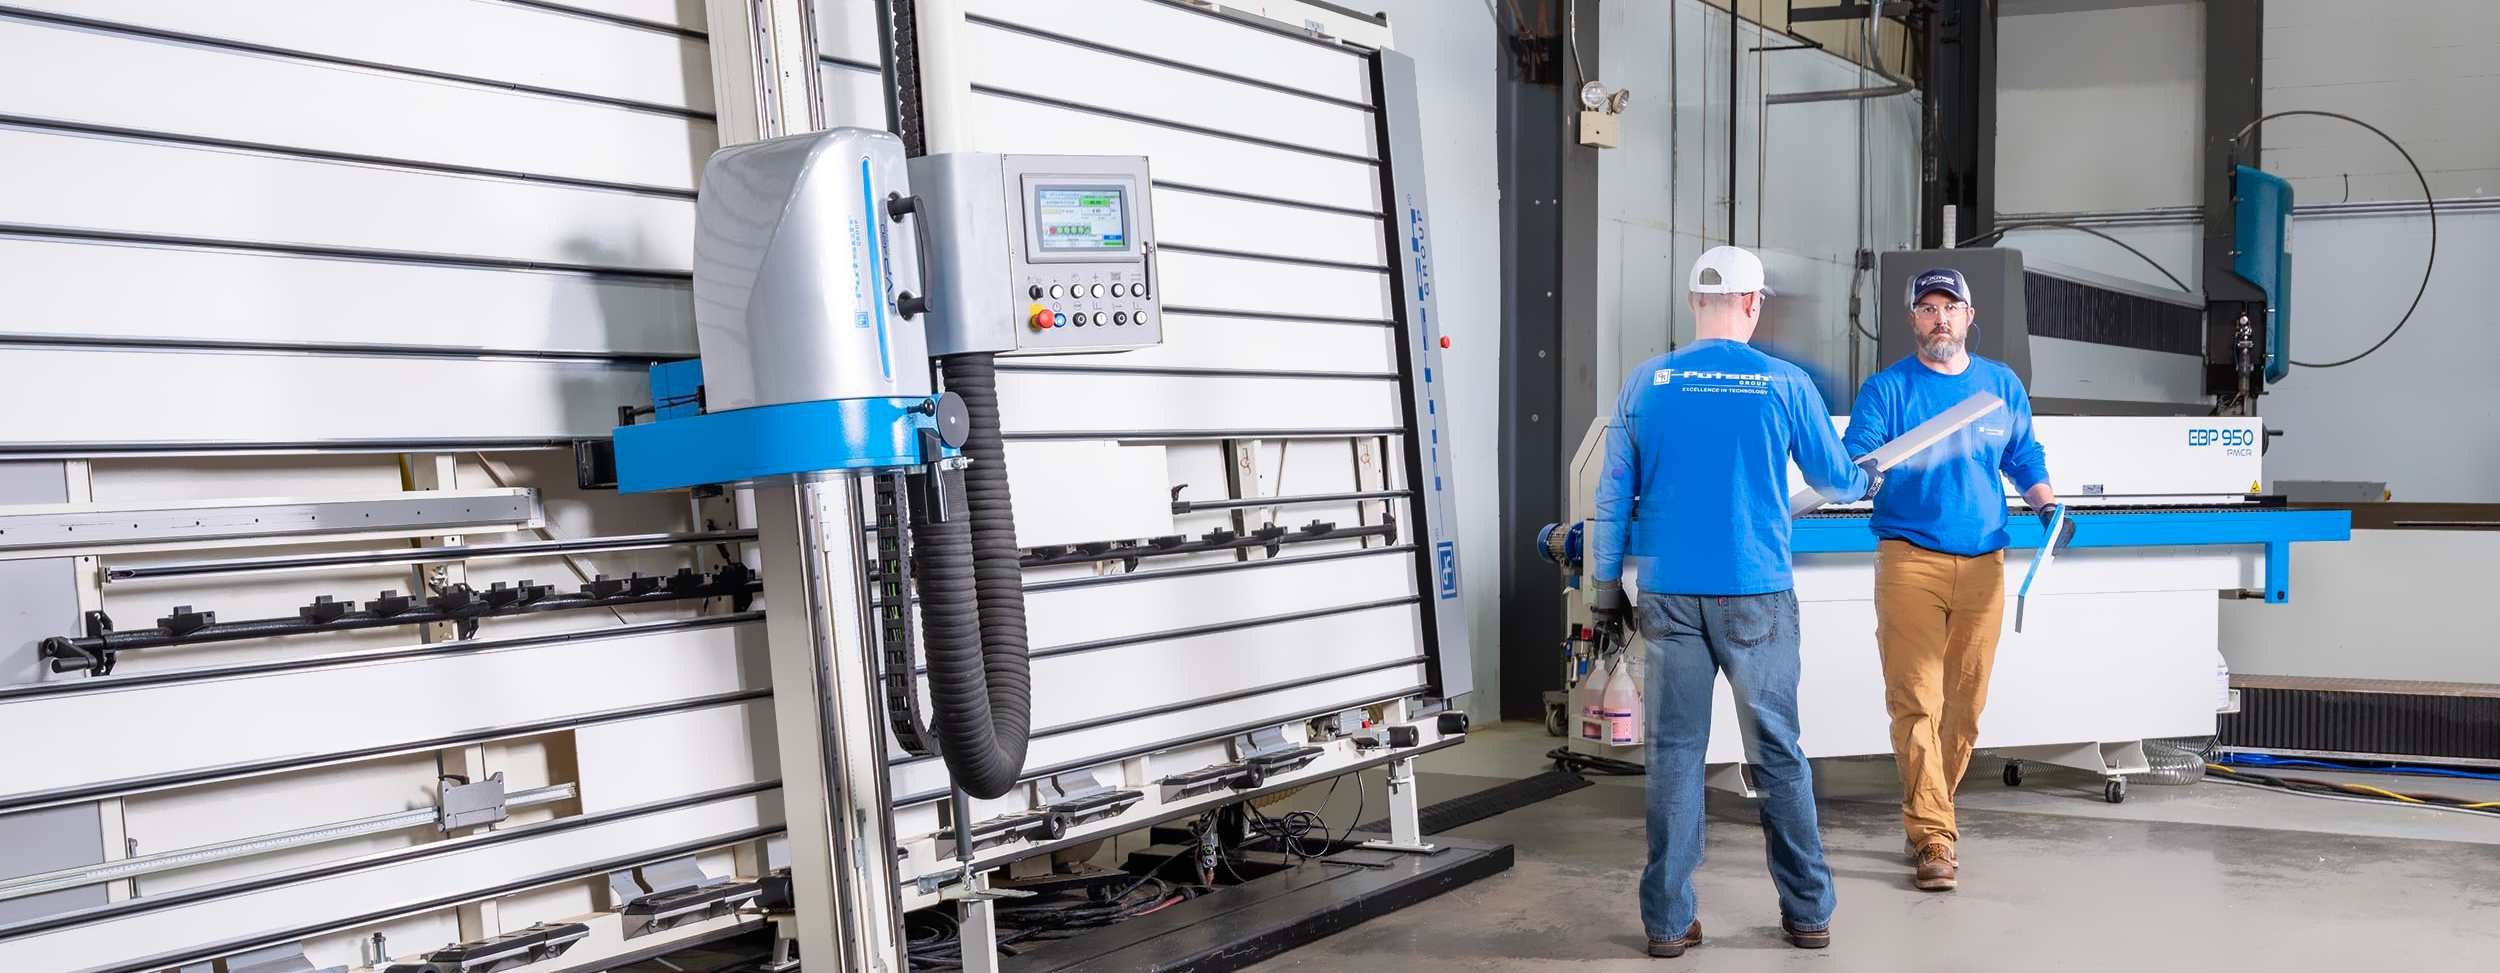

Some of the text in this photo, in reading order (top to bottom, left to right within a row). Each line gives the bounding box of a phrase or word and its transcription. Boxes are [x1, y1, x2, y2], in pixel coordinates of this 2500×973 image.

[1416, 209, 1431, 297] GROUP
[2188, 429, 2254, 446] EBP 950
